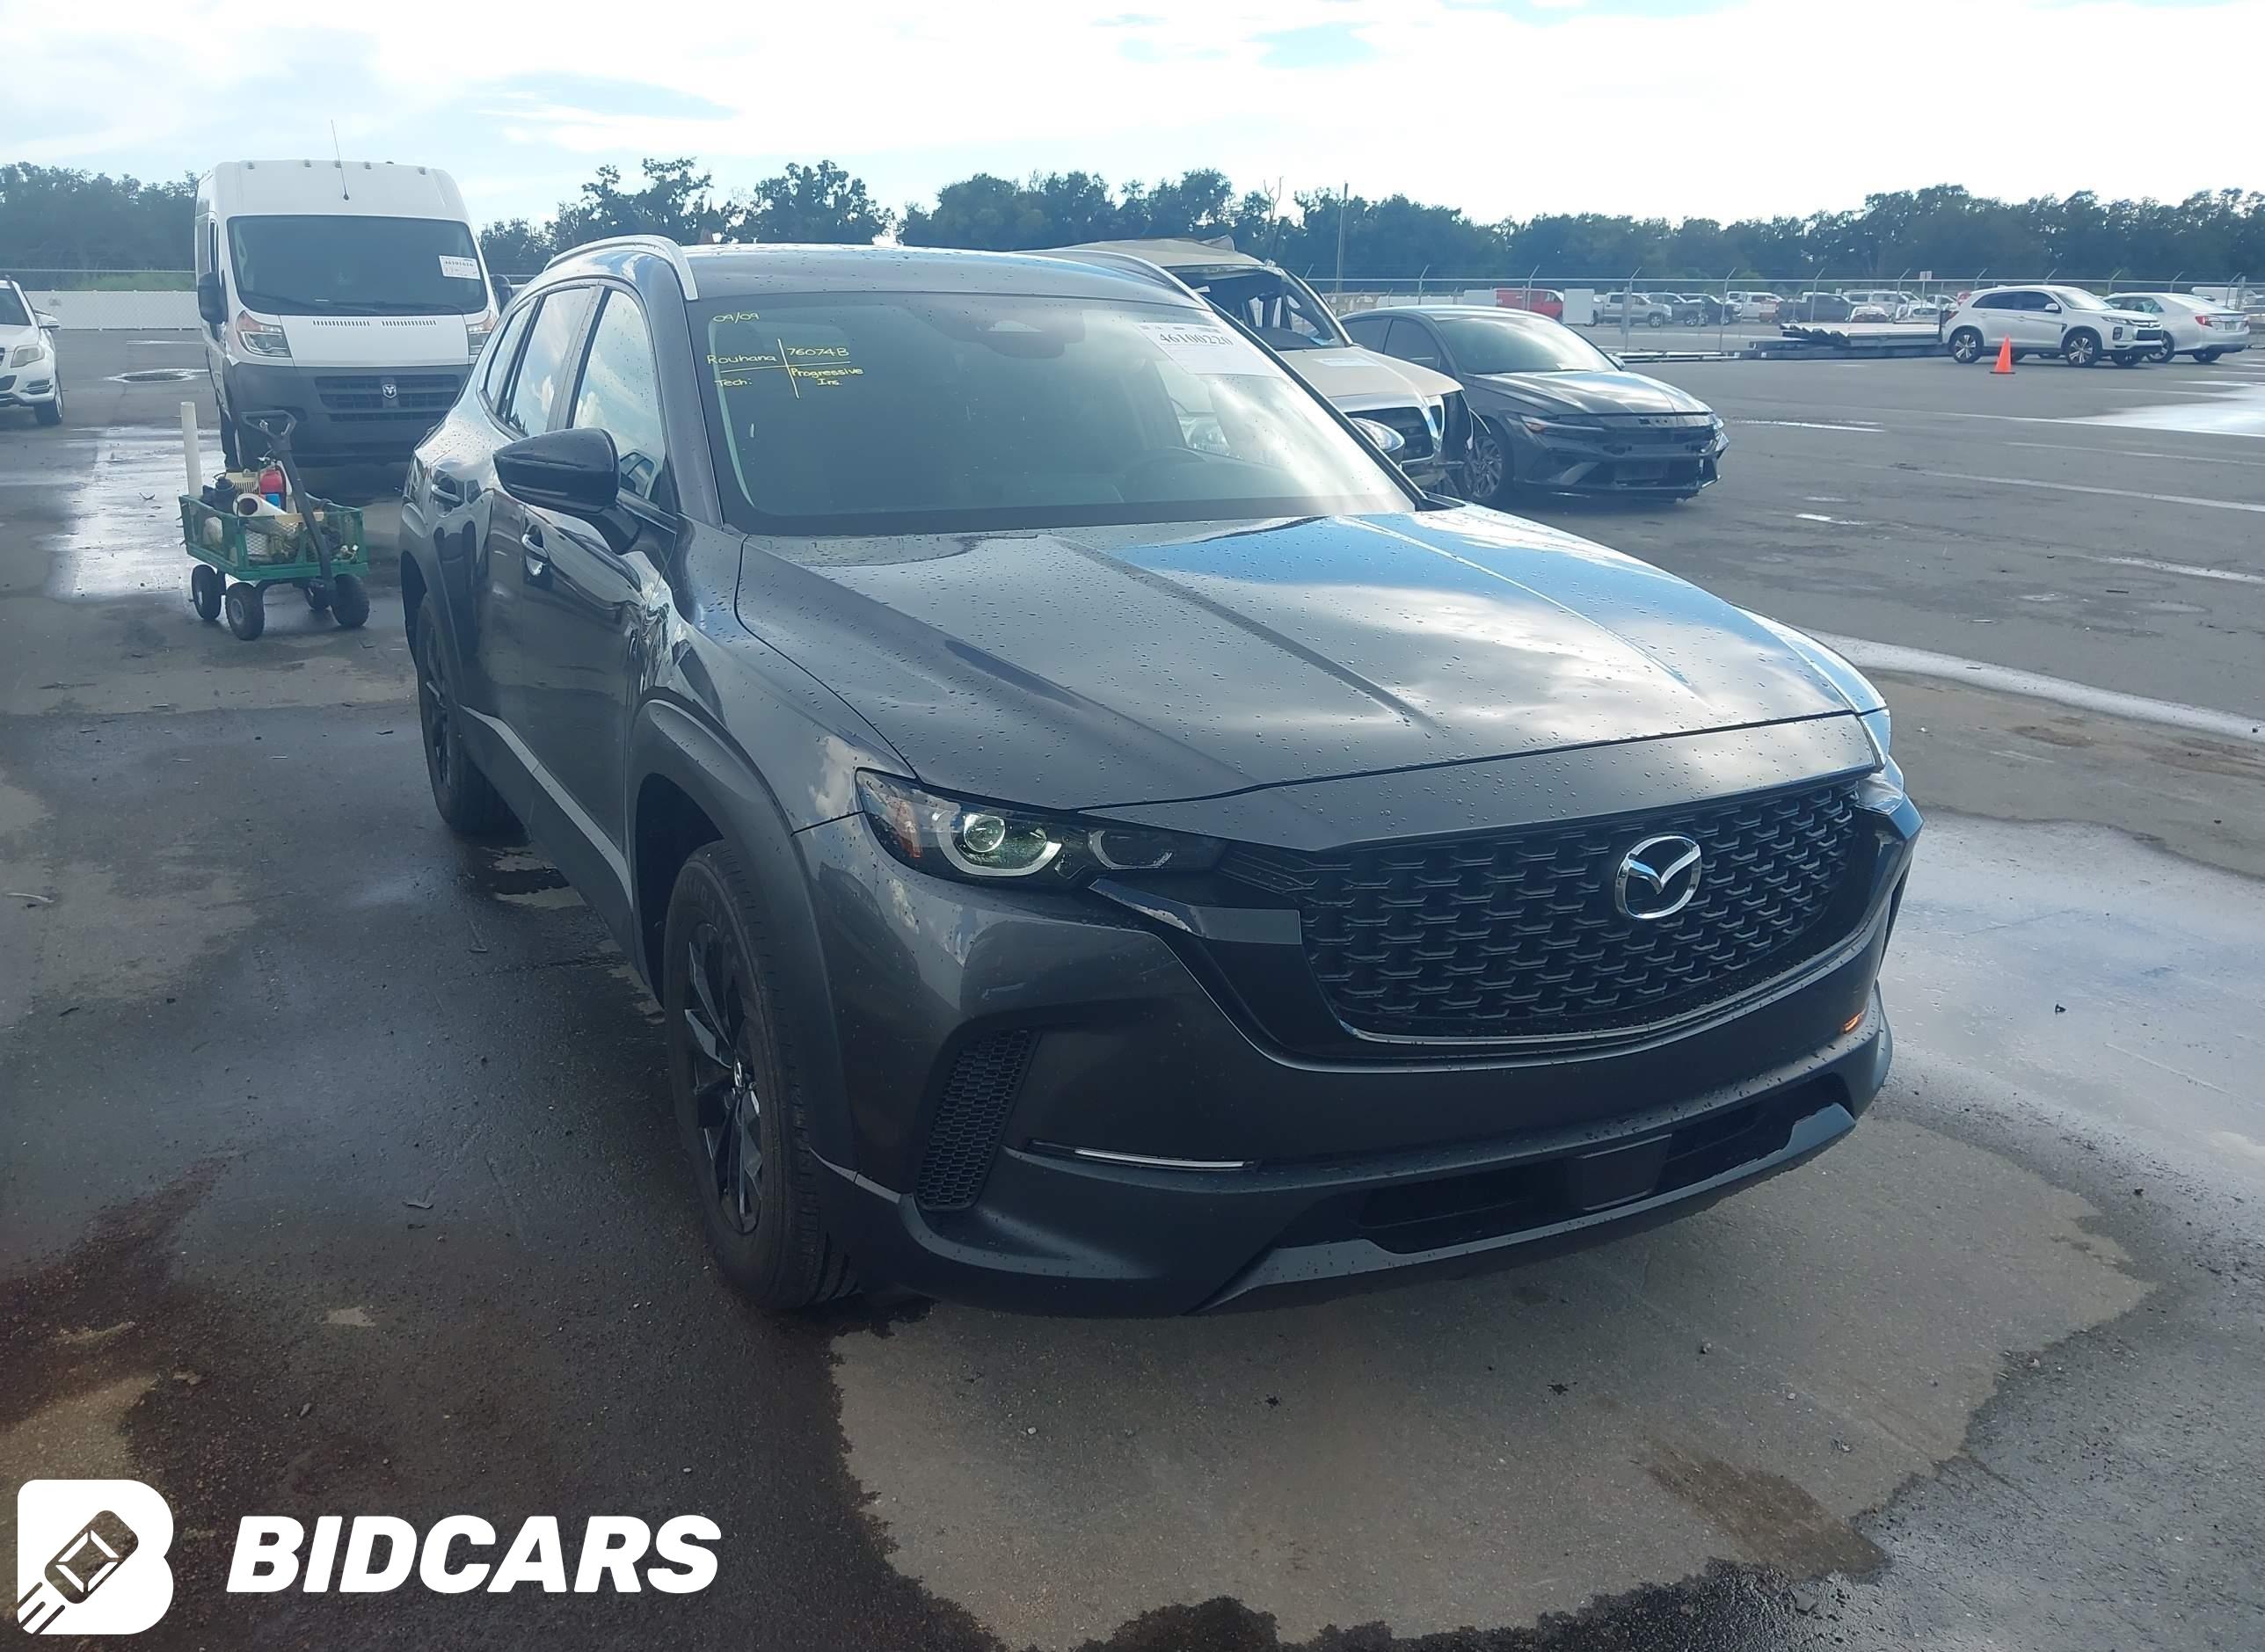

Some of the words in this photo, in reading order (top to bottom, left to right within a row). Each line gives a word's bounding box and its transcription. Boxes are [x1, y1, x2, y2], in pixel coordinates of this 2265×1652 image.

[712, 311, 760, 324] 09/09
[707, 354, 778, 365] Rouhana
[790, 367, 864, 379] Progressive
[714, 378, 754, 388] Tech:
[816, 378, 843, 387] Ins.
